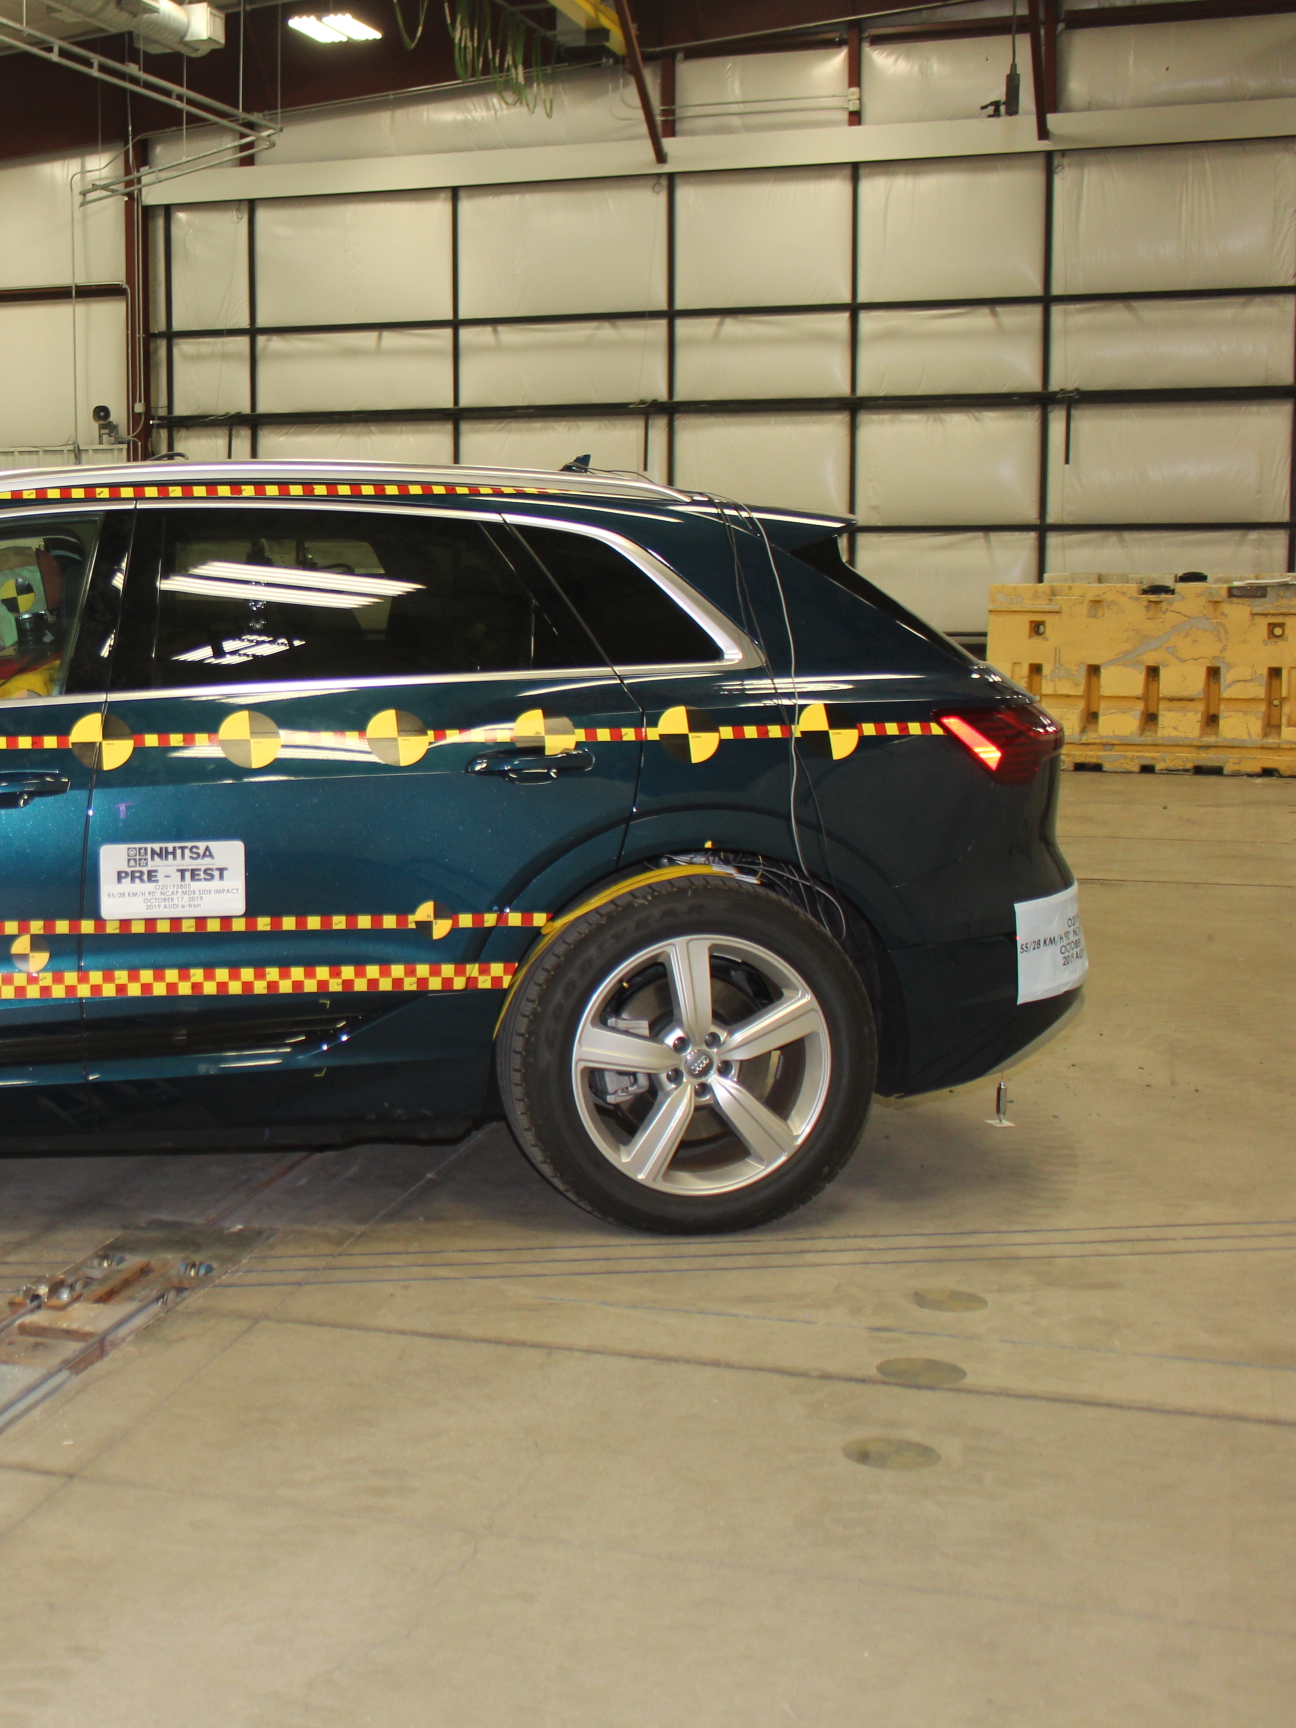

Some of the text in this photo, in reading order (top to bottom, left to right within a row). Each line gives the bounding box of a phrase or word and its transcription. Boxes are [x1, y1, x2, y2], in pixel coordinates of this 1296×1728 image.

[150, 845, 215, 861] NHTSA
[116, 869, 159, 884] PRE
[176, 867, 228, 882] TEST
[188, 895, 204, 903] 2019
[1020, 939, 1041, 954] 55/28
[1043, 934, 1064, 948] KM/H
